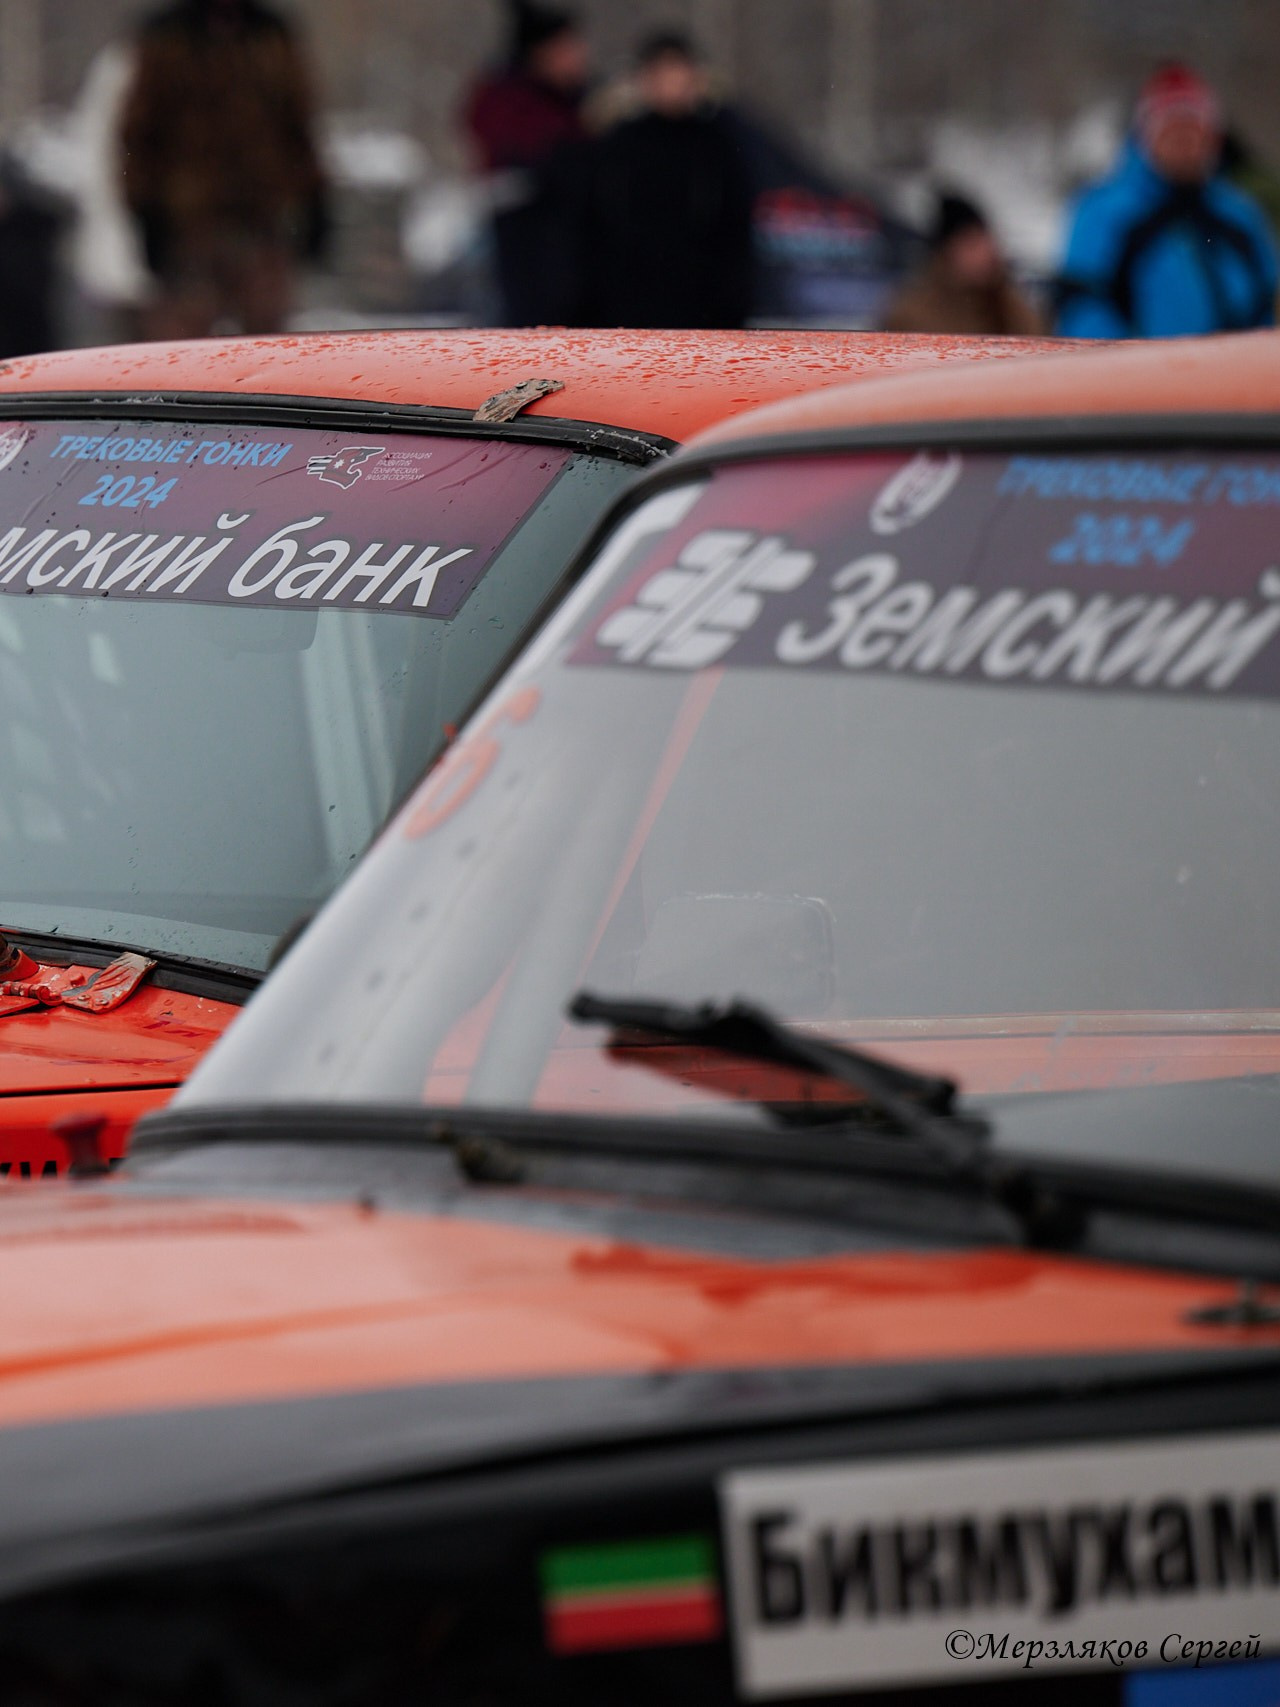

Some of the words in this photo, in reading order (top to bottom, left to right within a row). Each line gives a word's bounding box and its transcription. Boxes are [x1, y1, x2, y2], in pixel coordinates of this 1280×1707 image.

[50, 435, 194, 463] ТРЕКОВЫЕ
[185, 441, 294, 467] ГОНКИ
[78, 474, 180, 508] 2024
[227, 515, 474, 608] банк
